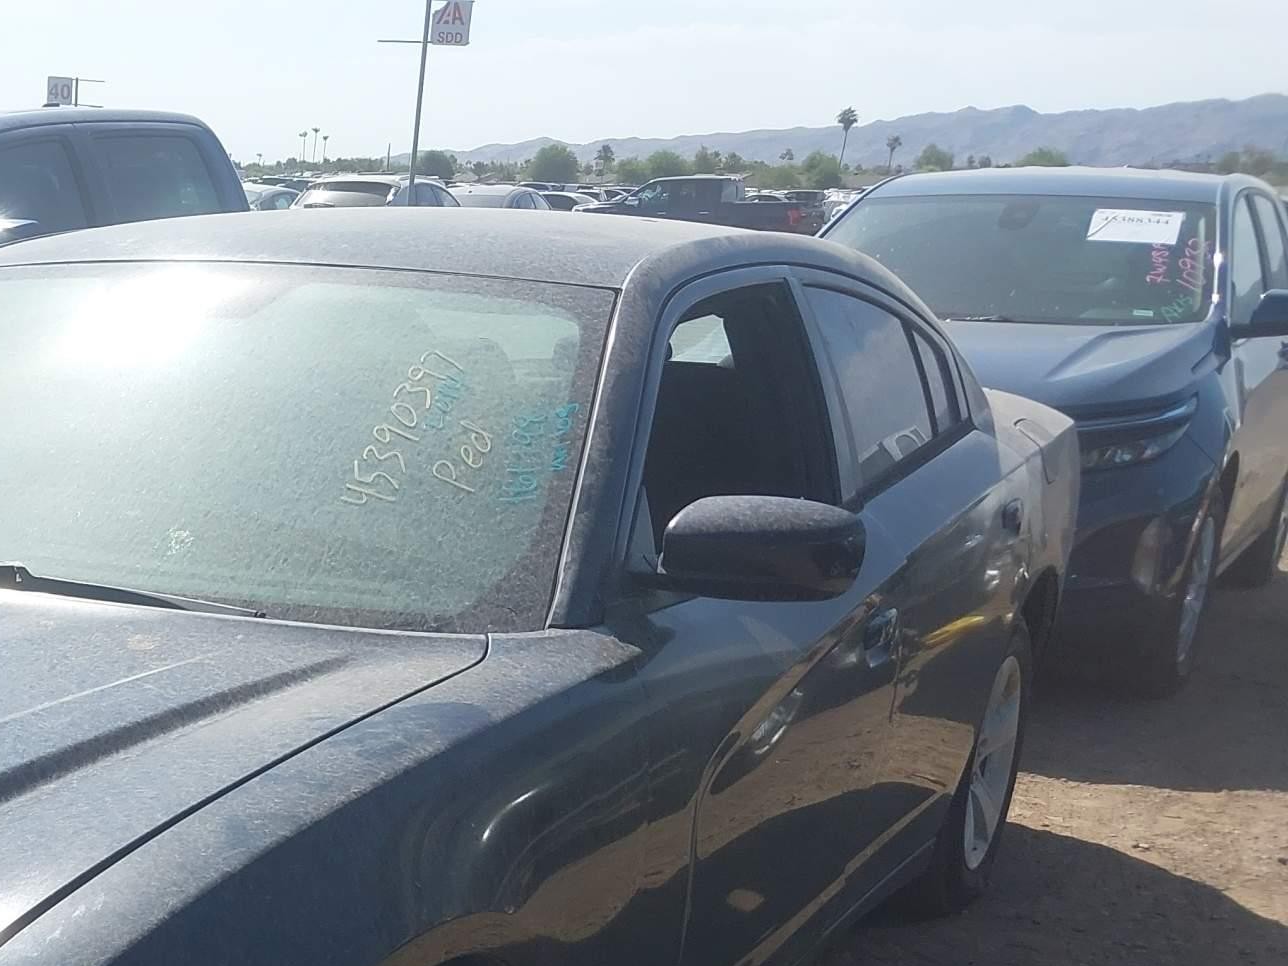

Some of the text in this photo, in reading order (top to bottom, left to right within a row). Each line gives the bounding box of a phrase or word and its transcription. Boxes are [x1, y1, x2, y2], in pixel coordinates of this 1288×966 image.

[437, 31, 464, 44] SDD
[49, 83, 71, 100] 40
[340, 350, 464, 505] 45390397
